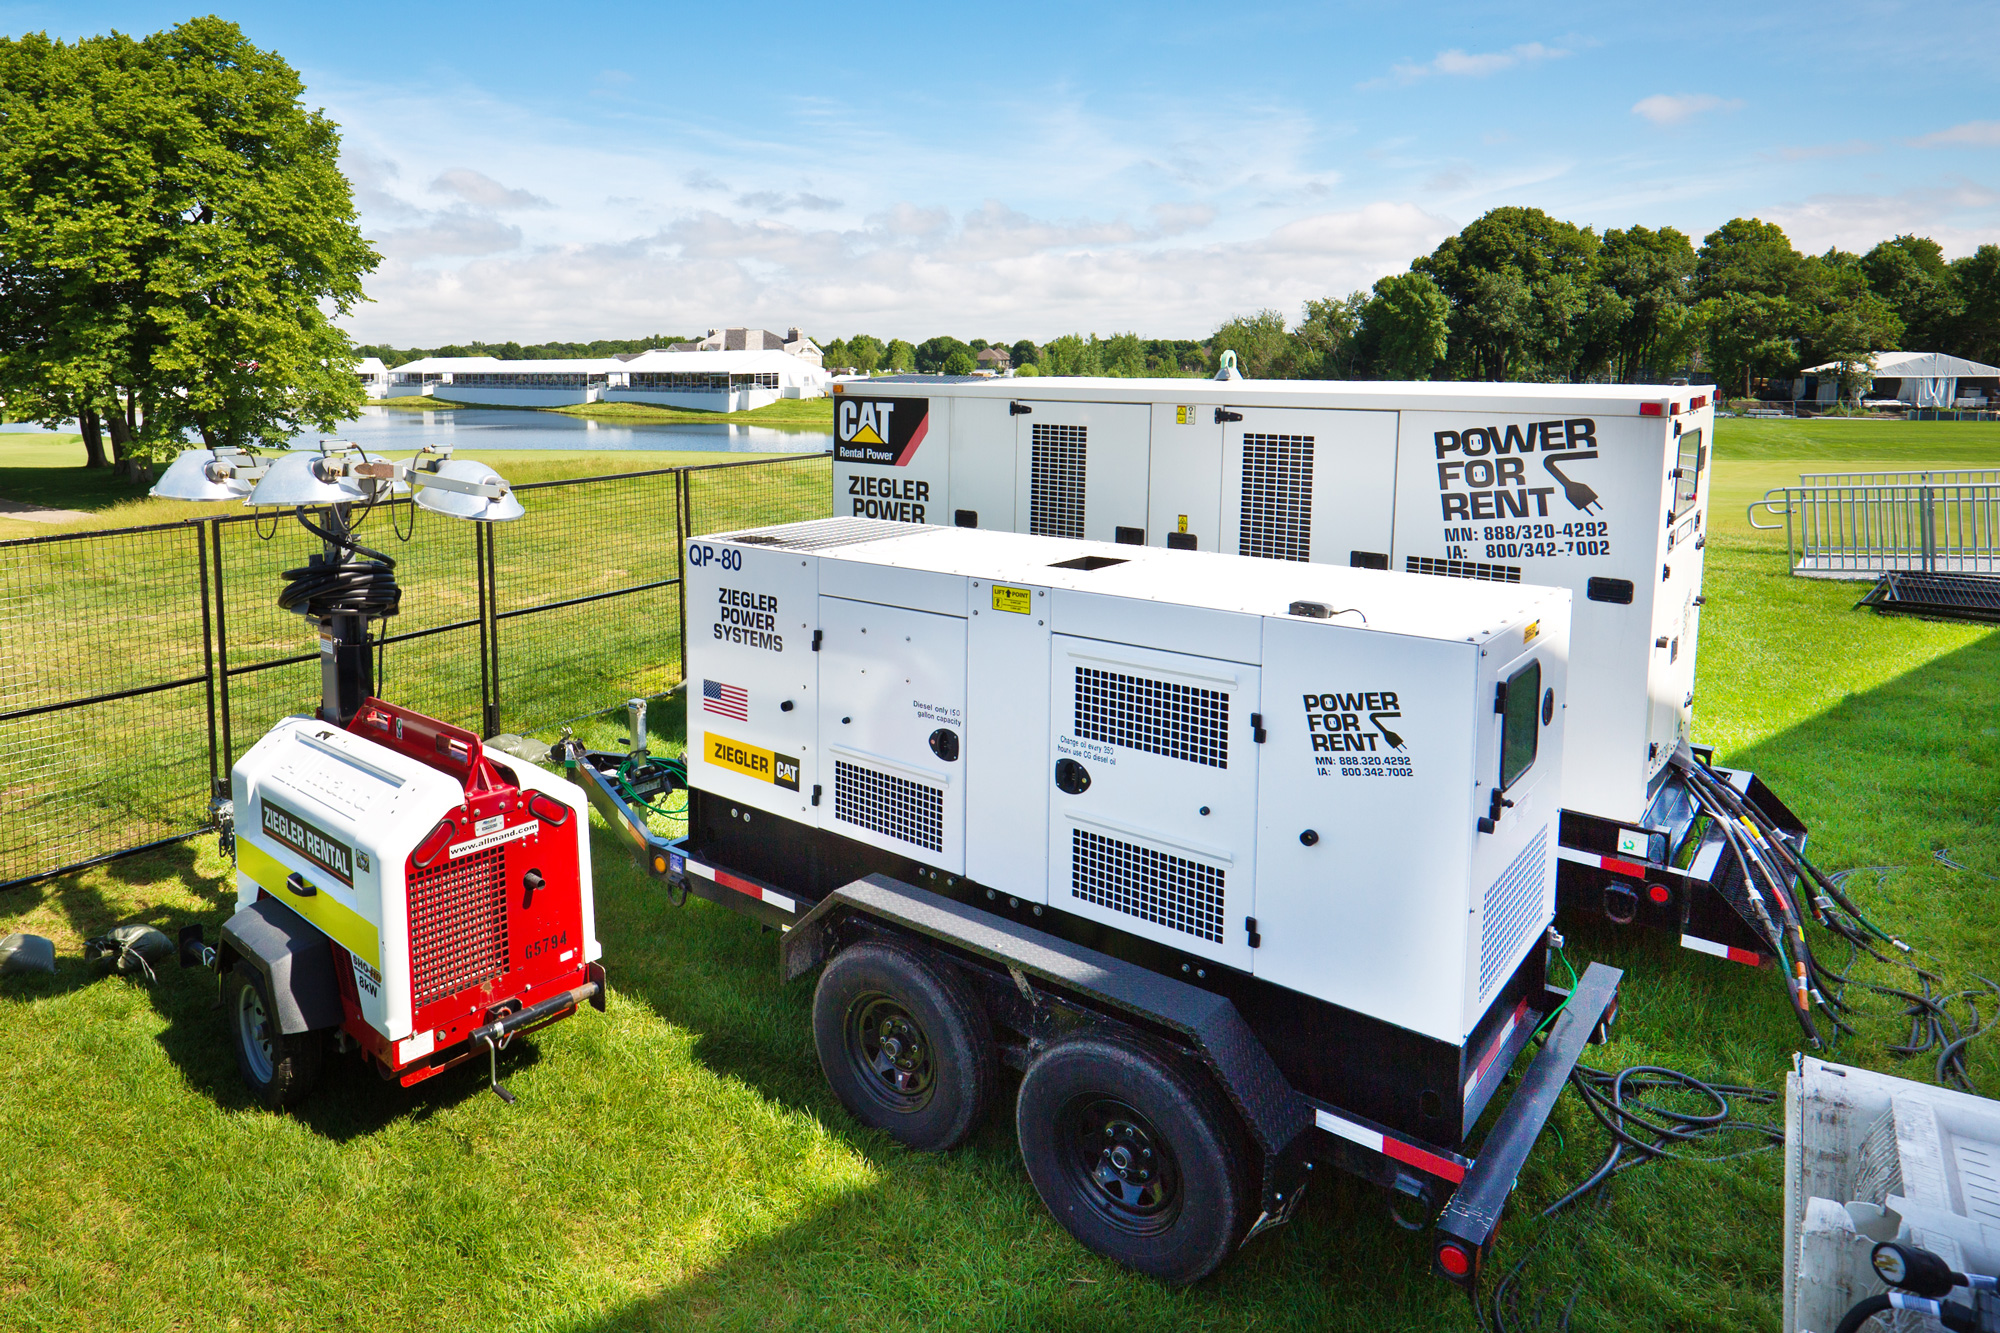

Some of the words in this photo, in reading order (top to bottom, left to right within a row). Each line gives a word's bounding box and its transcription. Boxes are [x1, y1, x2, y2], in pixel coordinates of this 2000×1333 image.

[839, 400, 894, 444] CAT
[1434, 418, 1598, 459] POWER
[840, 446, 864, 459] Rental
[866, 448, 893, 461] Power
[1437, 457, 1526, 490] FOR
[848, 475, 930, 502] ZIEGLER
[853, 497, 926, 524] POWER
[1441, 487, 1555, 521] RENT
[1444, 527, 1479, 542] MN:
[1484, 521, 1608, 541] 888/320-4292
[689, 544, 742, 571] QP-80
[1446, 545, 1468, 560] IA:
[1486, 540, 1610, 559] 800/342-7002
[718, 587, 778, 614] ZIEGLER
[1011, 591, 1029, 599] POINT
[721, 606, 775, 632] POWER
[713, 623, 783, 653] SYSTEMS
[913, 700, 933, 711] Diesel
[934, 706, 948, 716] only
[1303, 692, 1400, 712] POWER
[917, 711, 935, 720] gallon
[936, 715, 962, 728] capacity
[1306, 713, 1361, 732] FOR
[1060, 735, 1079, 748] Change
[1310, 733, 1378, 752] RENT
[714, 742, 769, 774] ZIEGLER
[776, 761, 799, 783] CAT
[1072, 750, 1082, 758] use
[1093, 753, 1109, 765] diesel
[1109, 758, 1117, 766] oil
[1315, 756, 1336, 766] MN:
[1339, 756, 1411, 766] 888.320.4292
[1317, 767, 1331, 777] IA:
[1341, 767, 1414, 777] 800.342.7002
[263, 805, 305, 849] ZIEGLER
[306, 830, 350, 877] RENTAL
[450, 823, 538, 855] www.allmand.com
[525, 930, 567, 960] G5794
[359, 975, 378, 999] 8kW
